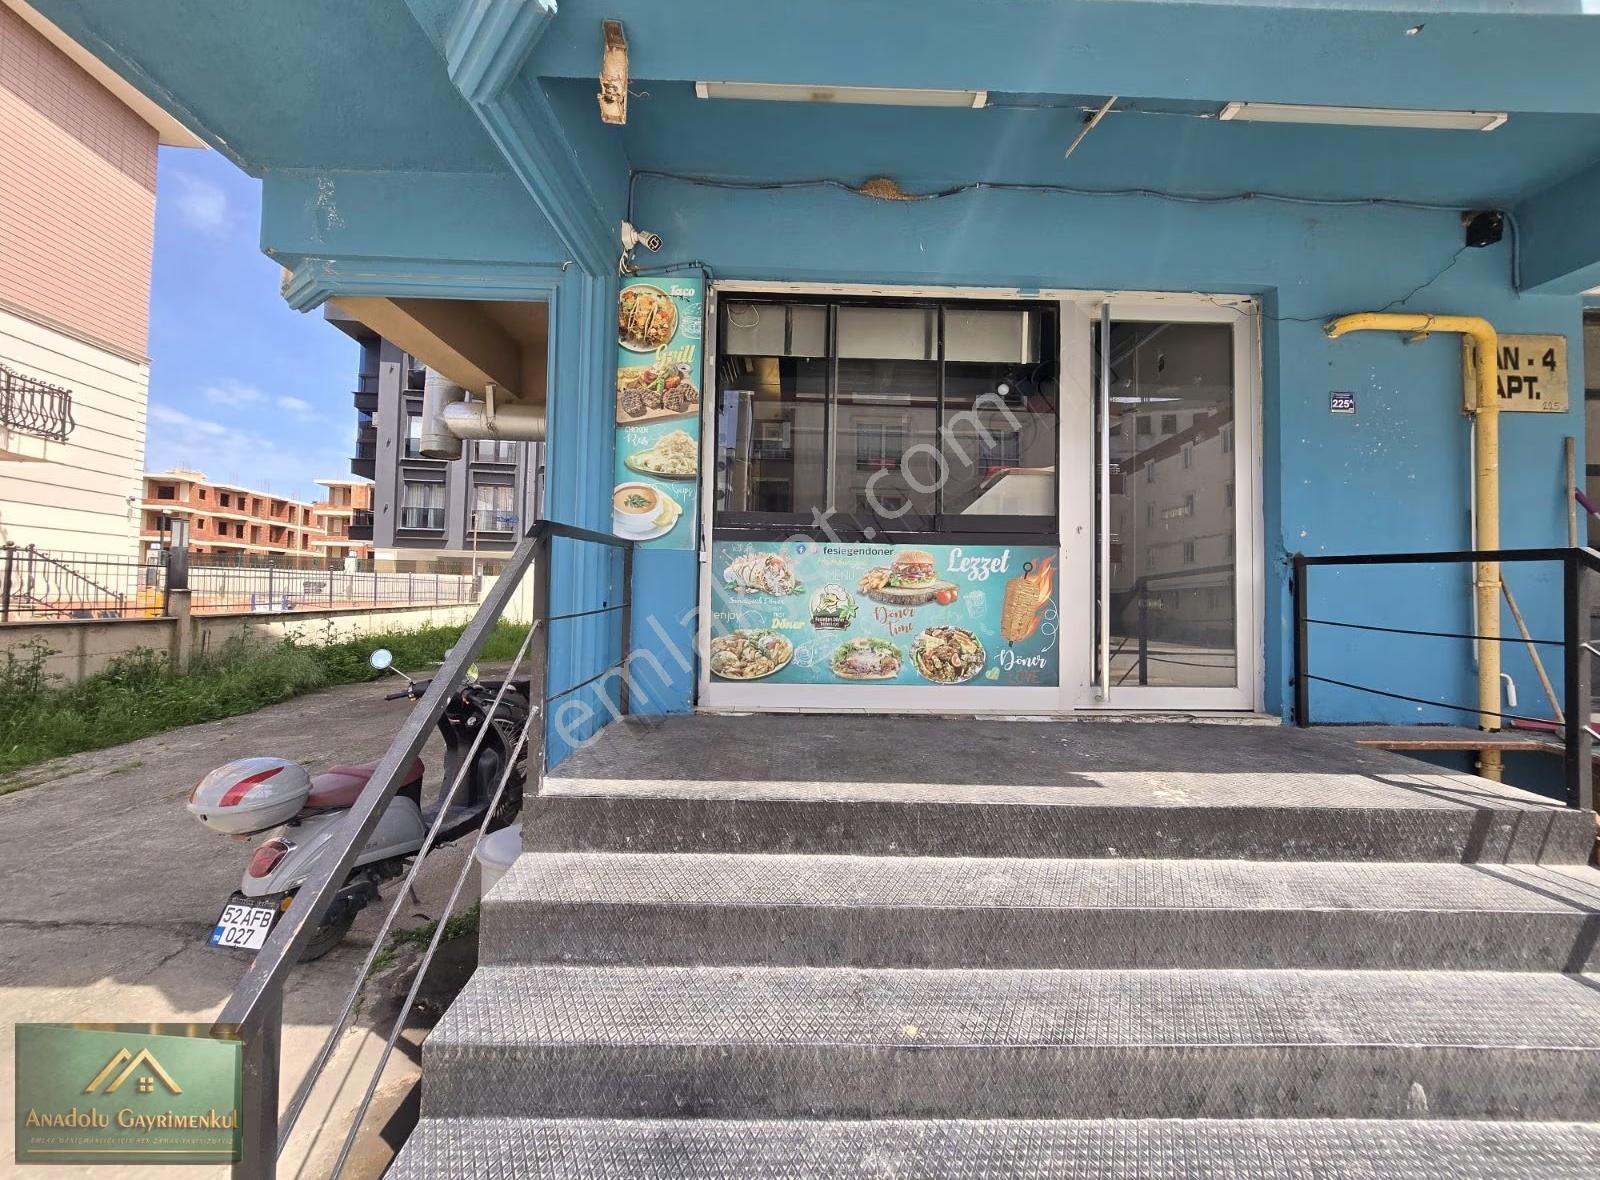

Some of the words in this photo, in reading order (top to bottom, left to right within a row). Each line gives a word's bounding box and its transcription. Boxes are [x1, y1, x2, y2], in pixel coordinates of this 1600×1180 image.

[670, 285, 696, 297] Taco
[1541, 347, 1556, 372] 4
[947, 547, 1010, 582] Lezzet
[994, 649, 1047, 671] Döner
[225, 927, 255, 945] 027
